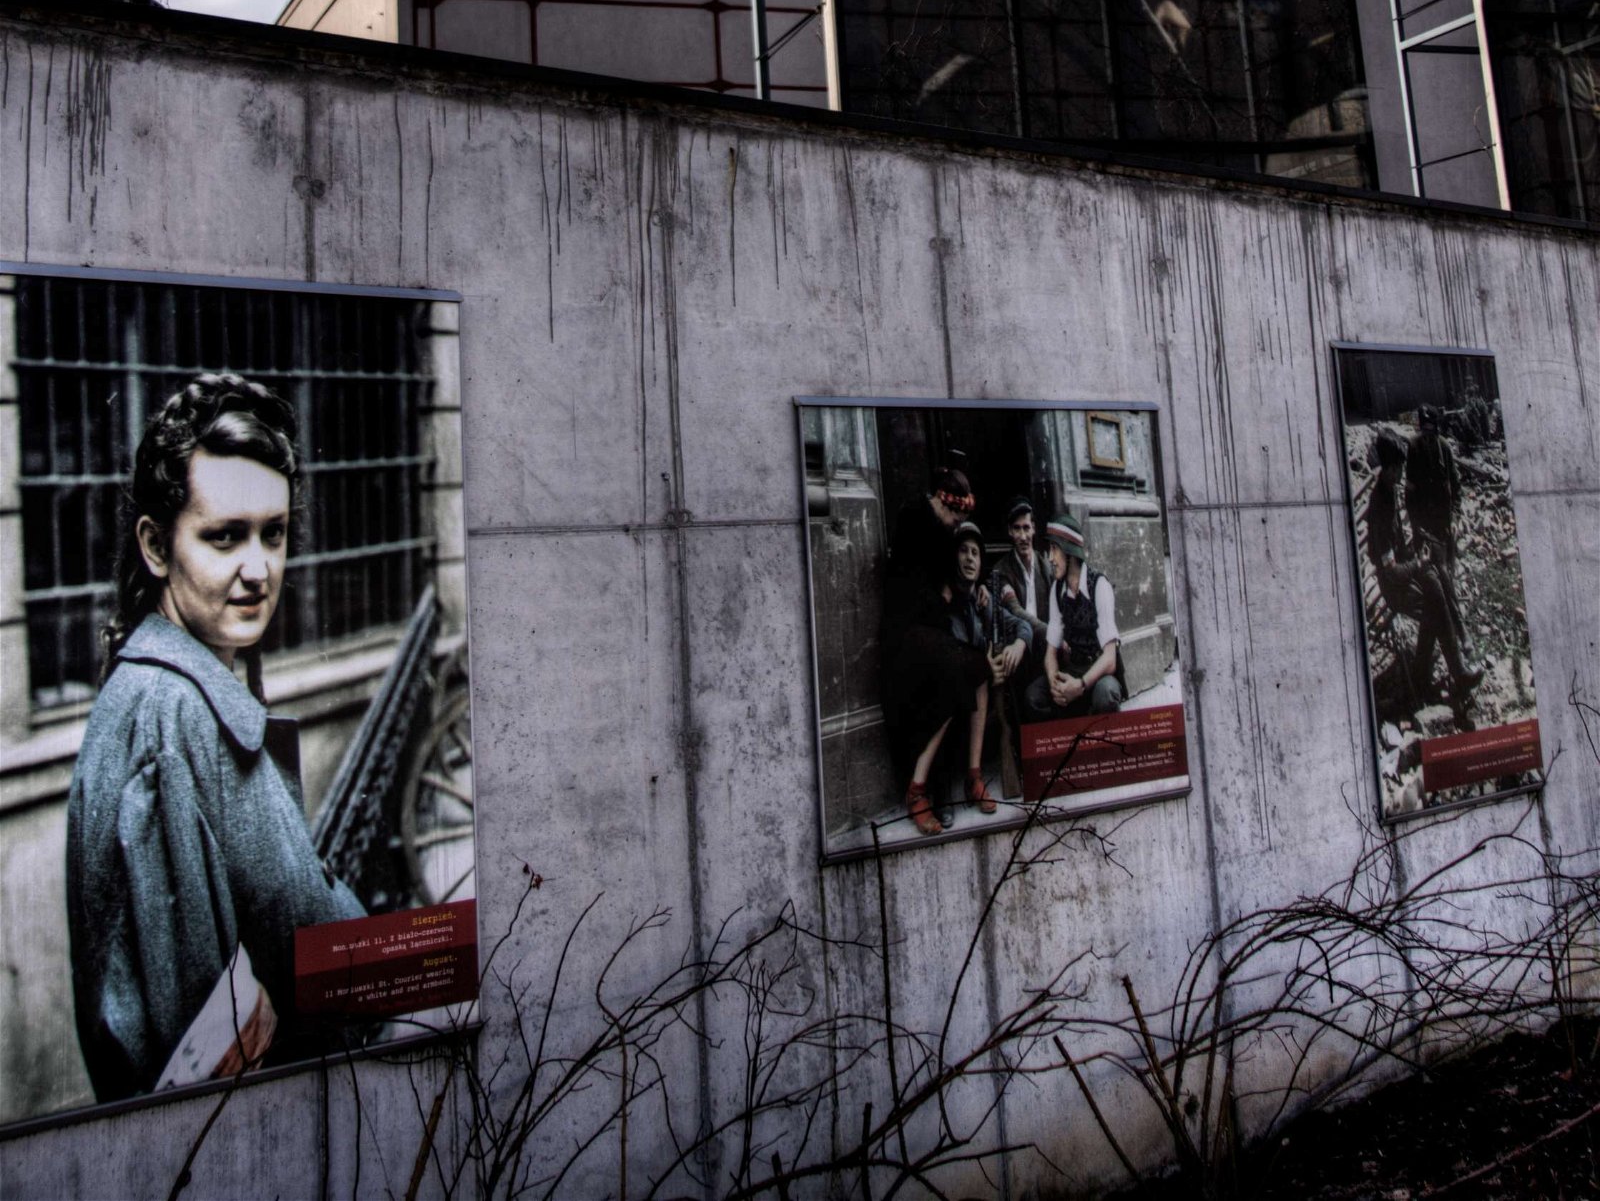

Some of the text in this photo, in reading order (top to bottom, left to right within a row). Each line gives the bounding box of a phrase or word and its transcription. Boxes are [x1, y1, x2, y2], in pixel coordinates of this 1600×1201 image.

[423, 954, 458, 968] August.
[394, 974, 423, 986] Courier
[426, 967, 454, 979] wearing
[366, 990, 387, 1001] white
[390, 986, 404, 996] and
[407, 983, 420, 993] red
[423, 978, 454, 989] armband.
